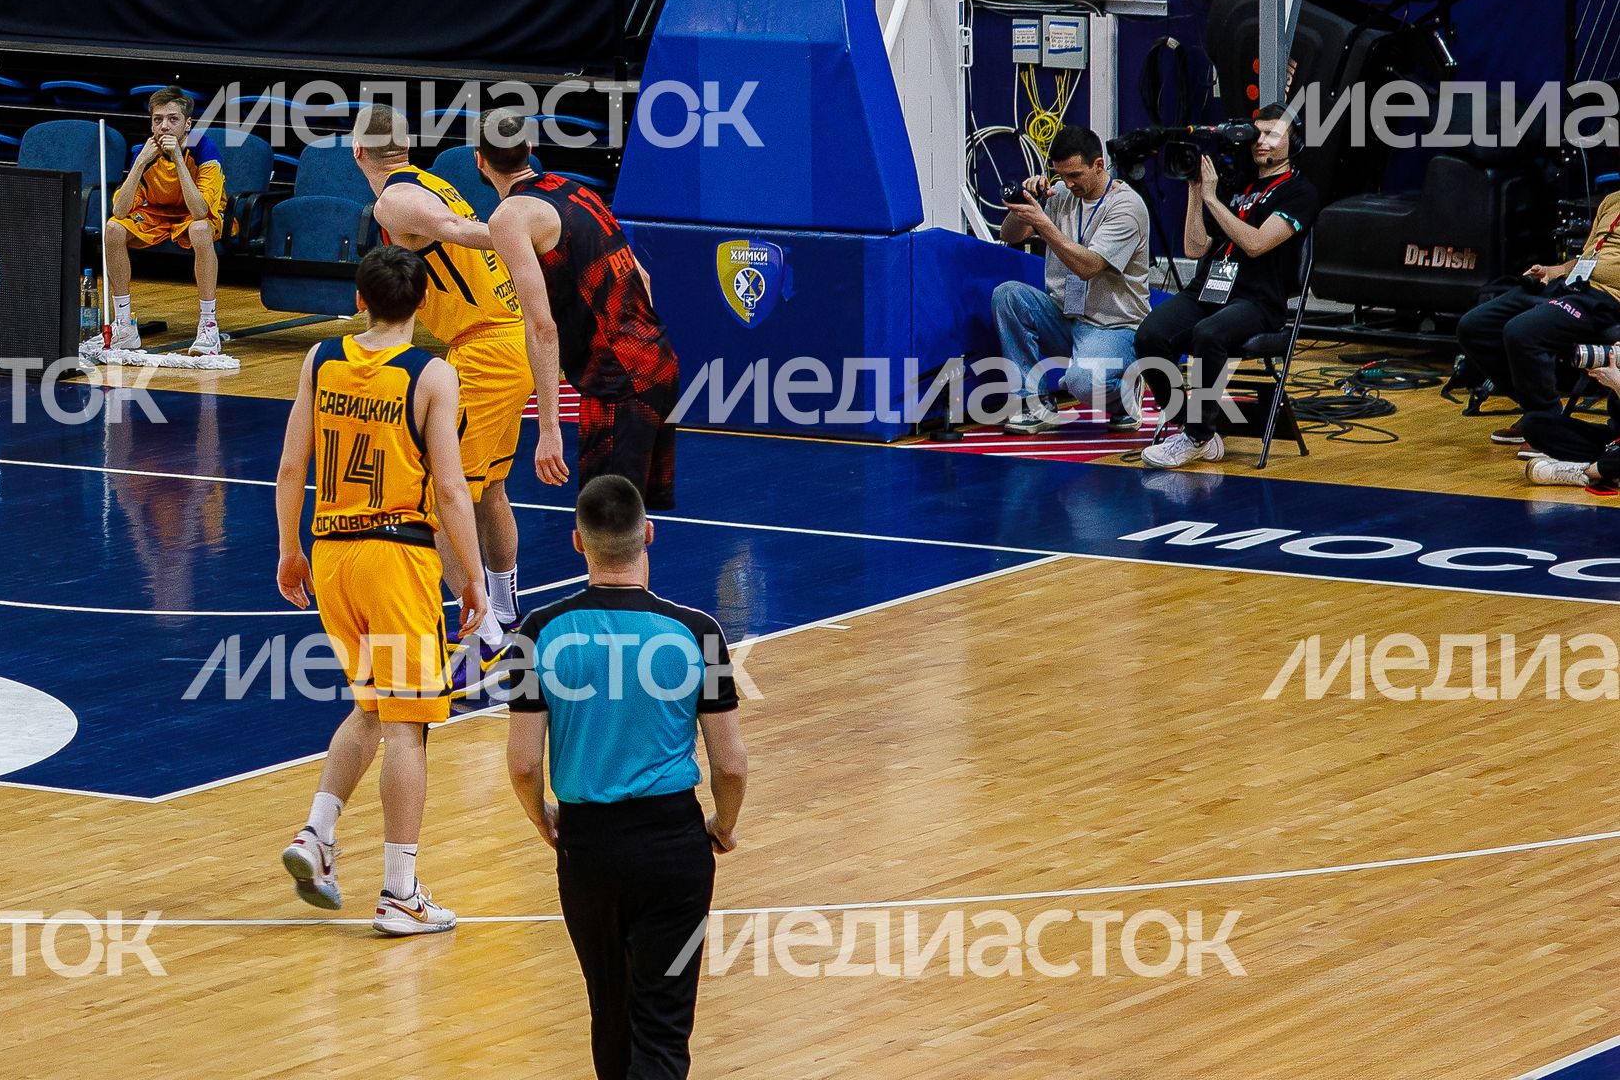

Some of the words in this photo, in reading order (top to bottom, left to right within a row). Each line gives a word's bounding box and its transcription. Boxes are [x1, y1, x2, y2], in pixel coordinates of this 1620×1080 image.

[730, 250, 768, 262] ХИМКИ
[318, 389, 405, 426] САВИЦКИЙ
[321, 428, 386, 510] 14
[315, 512, 403, 533] ОСКОВСКАЯ
